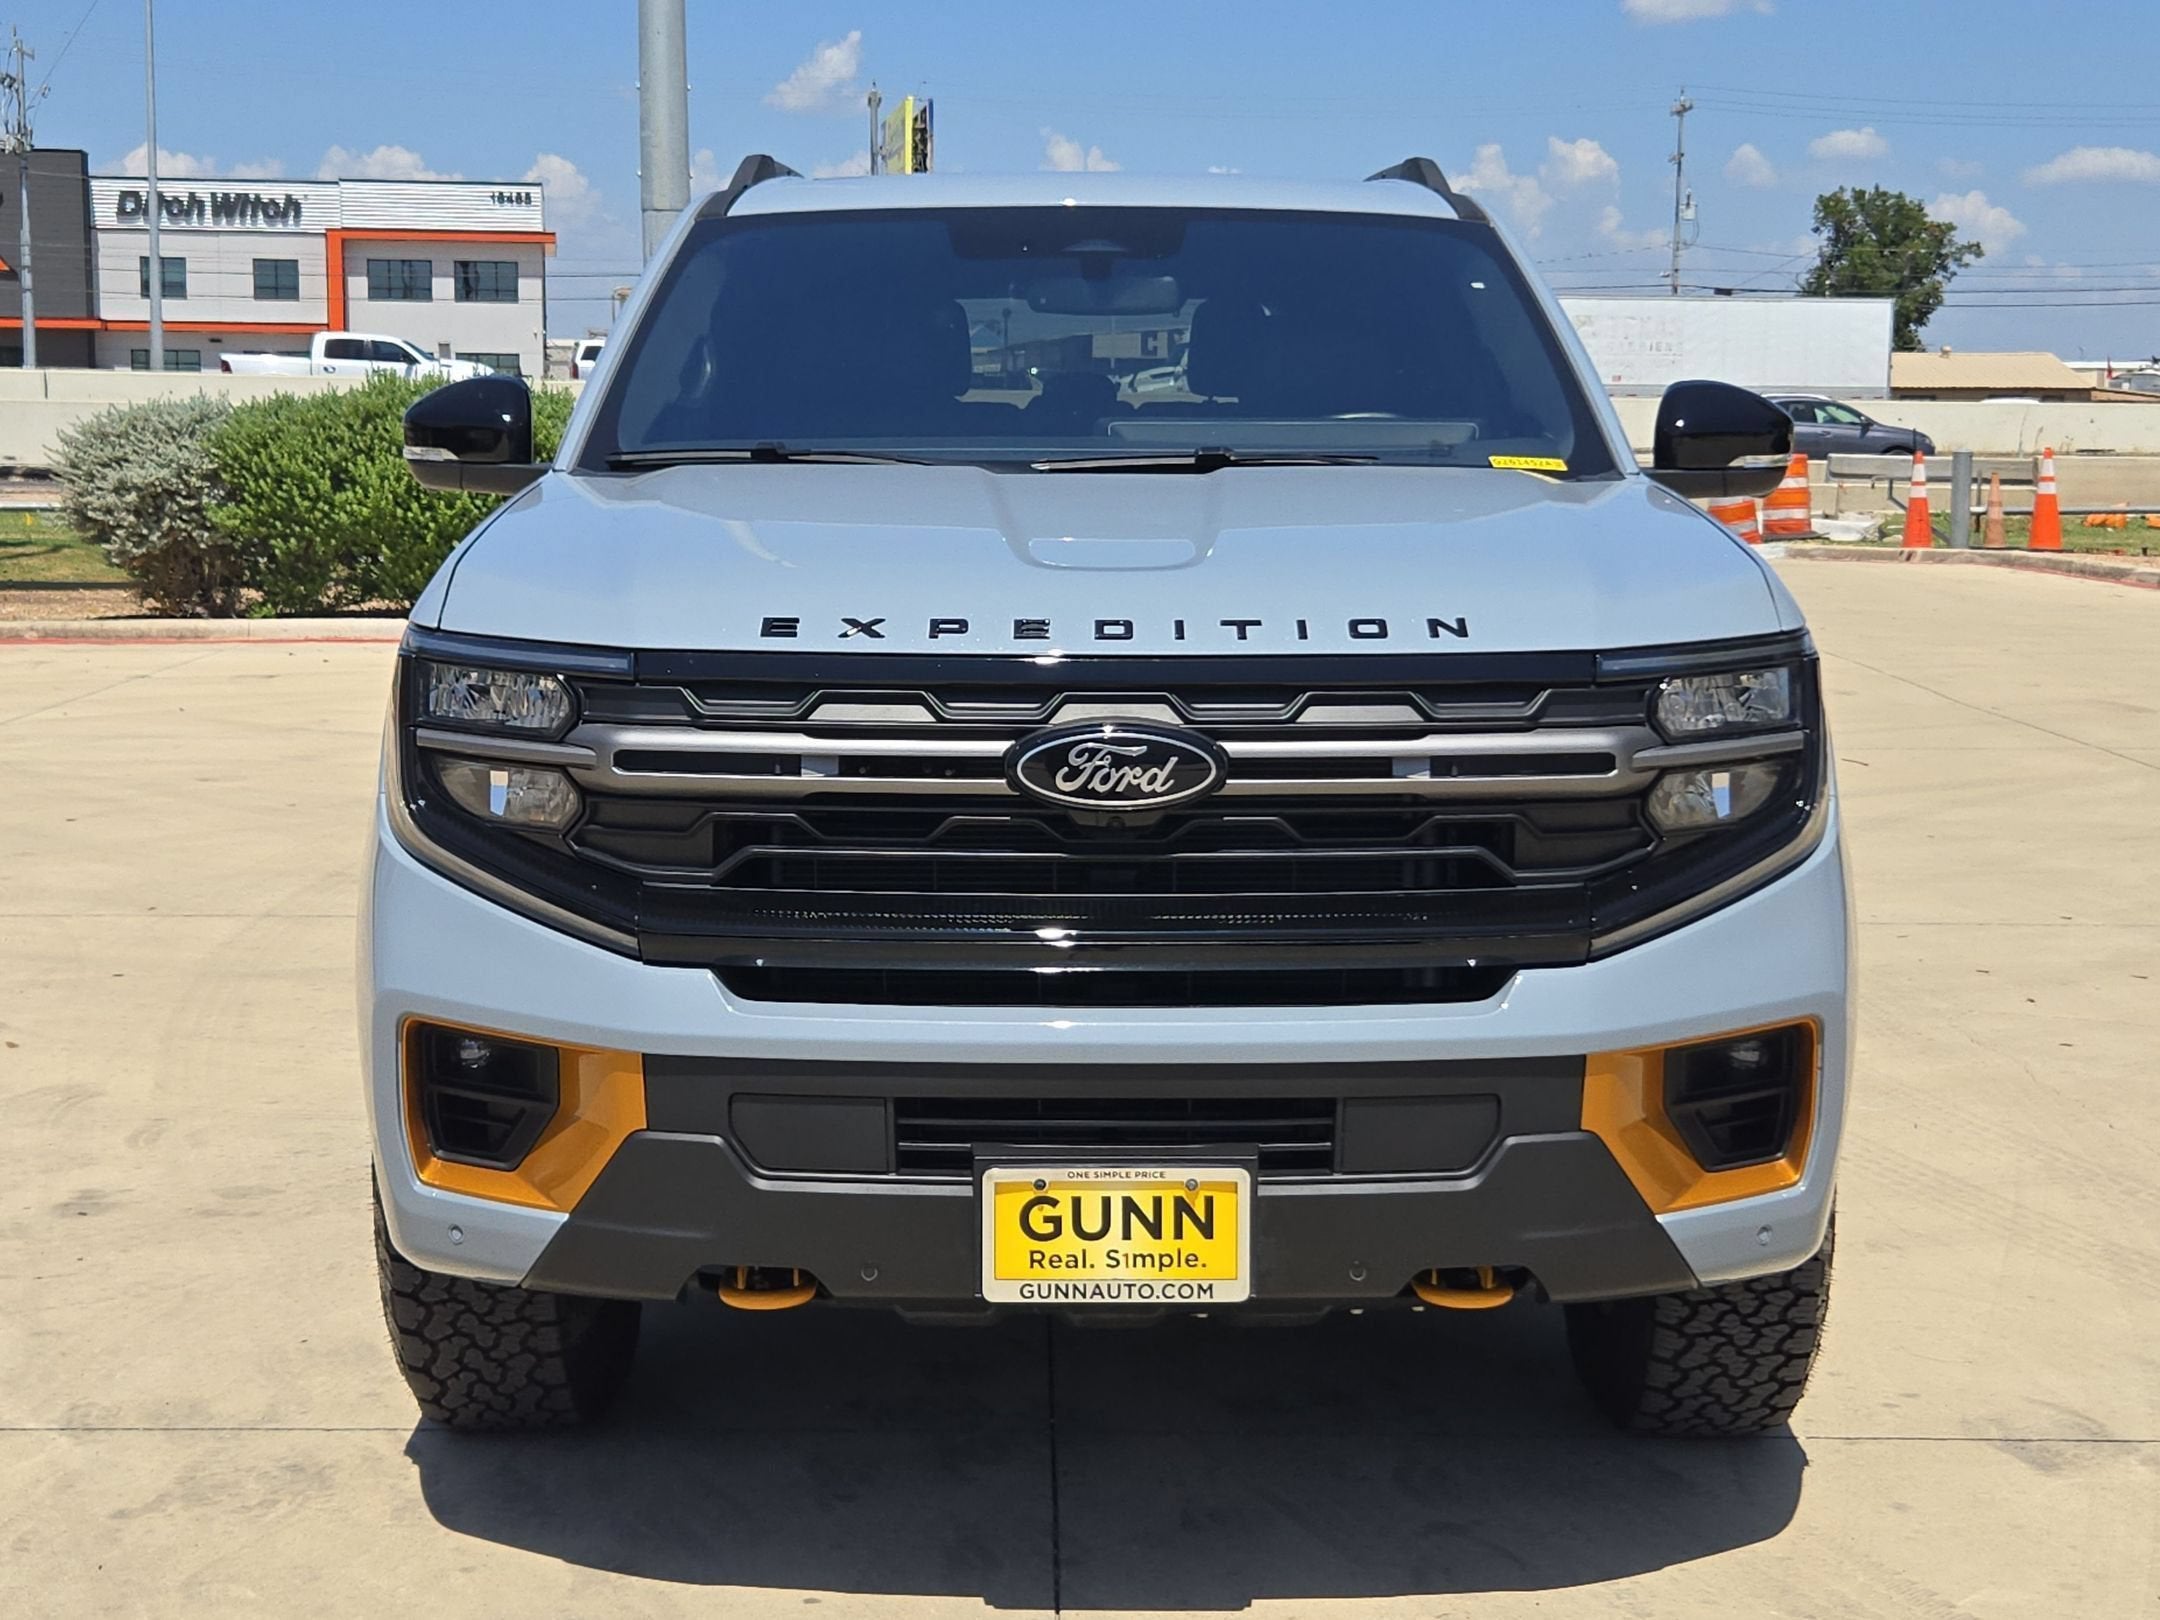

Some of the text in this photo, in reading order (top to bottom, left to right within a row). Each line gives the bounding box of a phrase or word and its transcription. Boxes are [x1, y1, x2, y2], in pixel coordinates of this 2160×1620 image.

[760, 616, 1470, 641] EXPEDITION
[1055, 742, 1179, 793] Ford
[1067, 1170, 1167, 1179] ONE SIMPLE PRICE
[1019, 1195, 1214, 1242] GUNN
[1029, 1248, 1095, 1269] Real.
[1019, 1283, 1214, 1299] GUNNAUTO.COM
